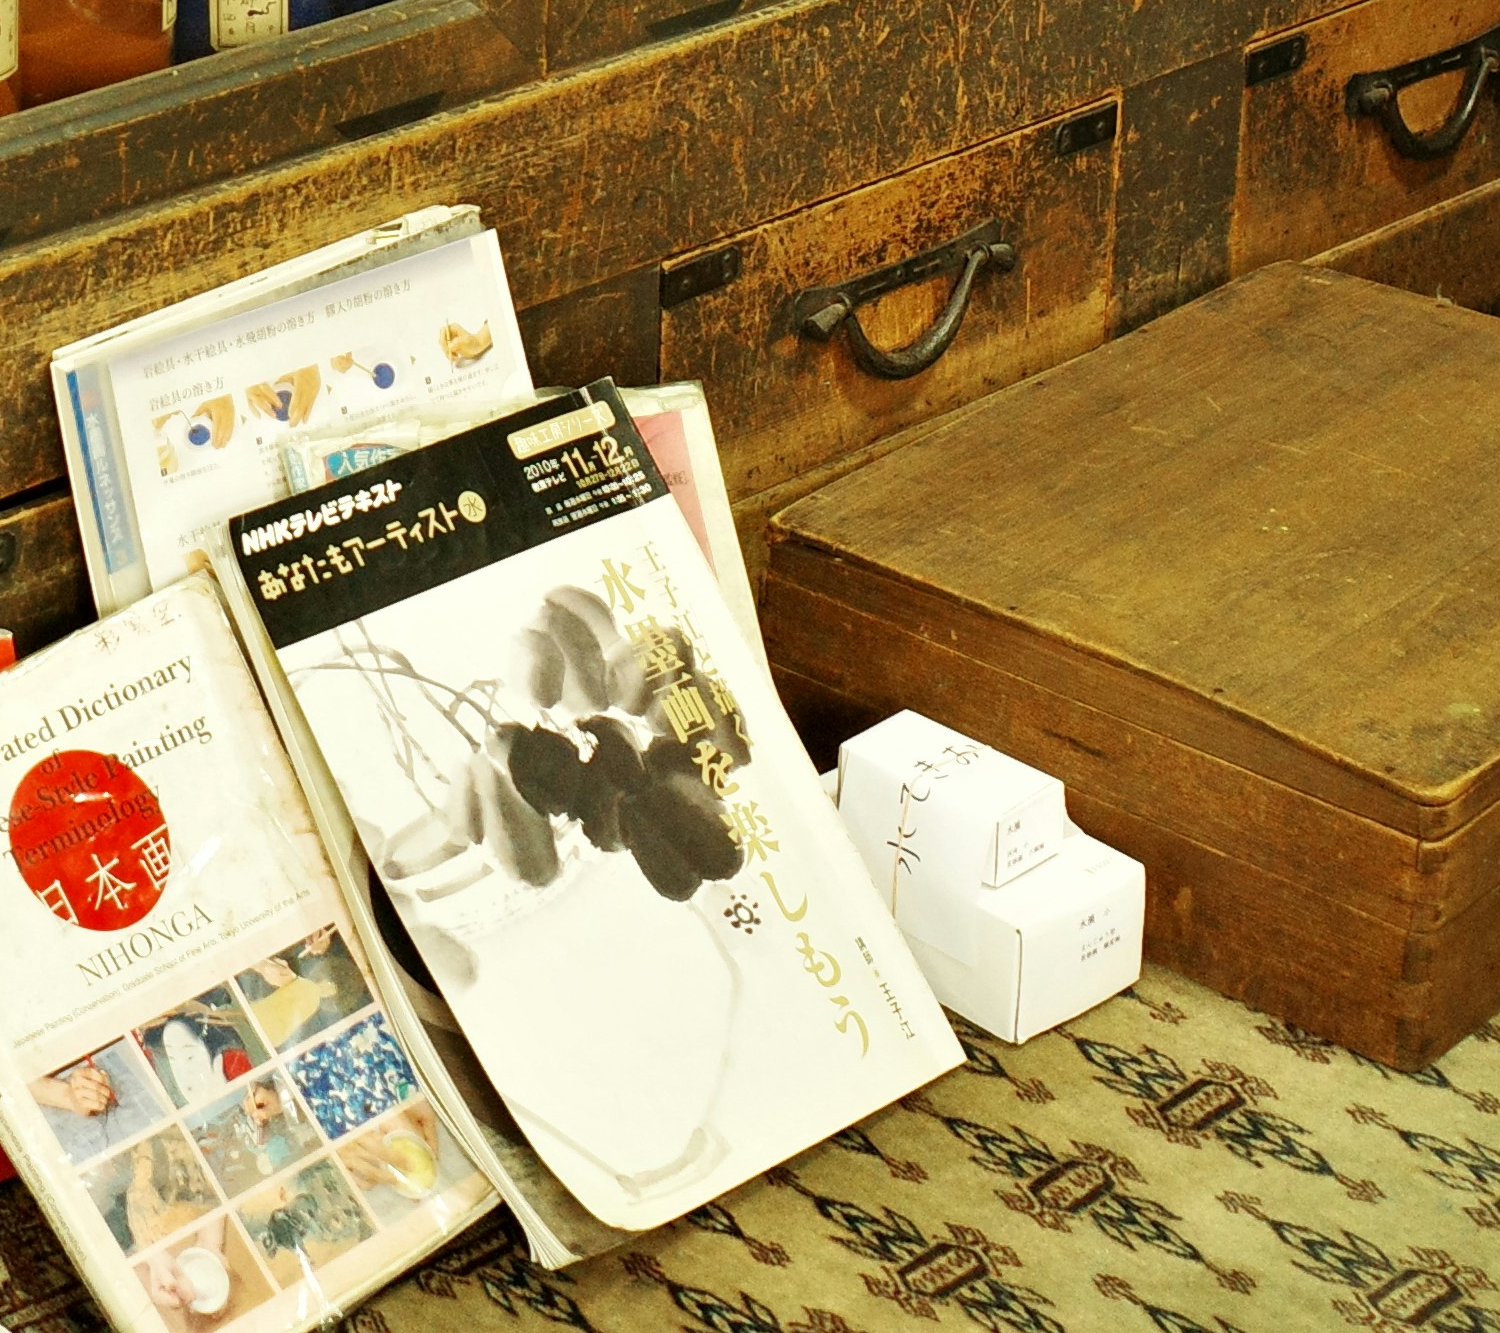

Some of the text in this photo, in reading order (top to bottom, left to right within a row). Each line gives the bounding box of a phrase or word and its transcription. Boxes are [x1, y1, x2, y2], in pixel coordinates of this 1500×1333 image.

[240, 480, 402, 556] NHKテレビテキスト
[257, 500, 458, 602] あなたもアーティスト
[635, 540, 755, 746] 王子江と描く
[57, 655, 193, 732] Dictionary
[40, 748, 64, 775] of
[105, 716, 212, 778] Painting
[2, 785, 162, 873] Terminology
[594, 556, 873, 1059] 水墨画を楽しもう
[36, 823, 171, 926] 日本画
[76, 903, 215, 987] NIHONGA
[186, 944, 202, 958] Fine
[239, 908, 274, 931] University
[295, 888, 311, 901] Arts
[879, 982, 916, 1041] 王子江
